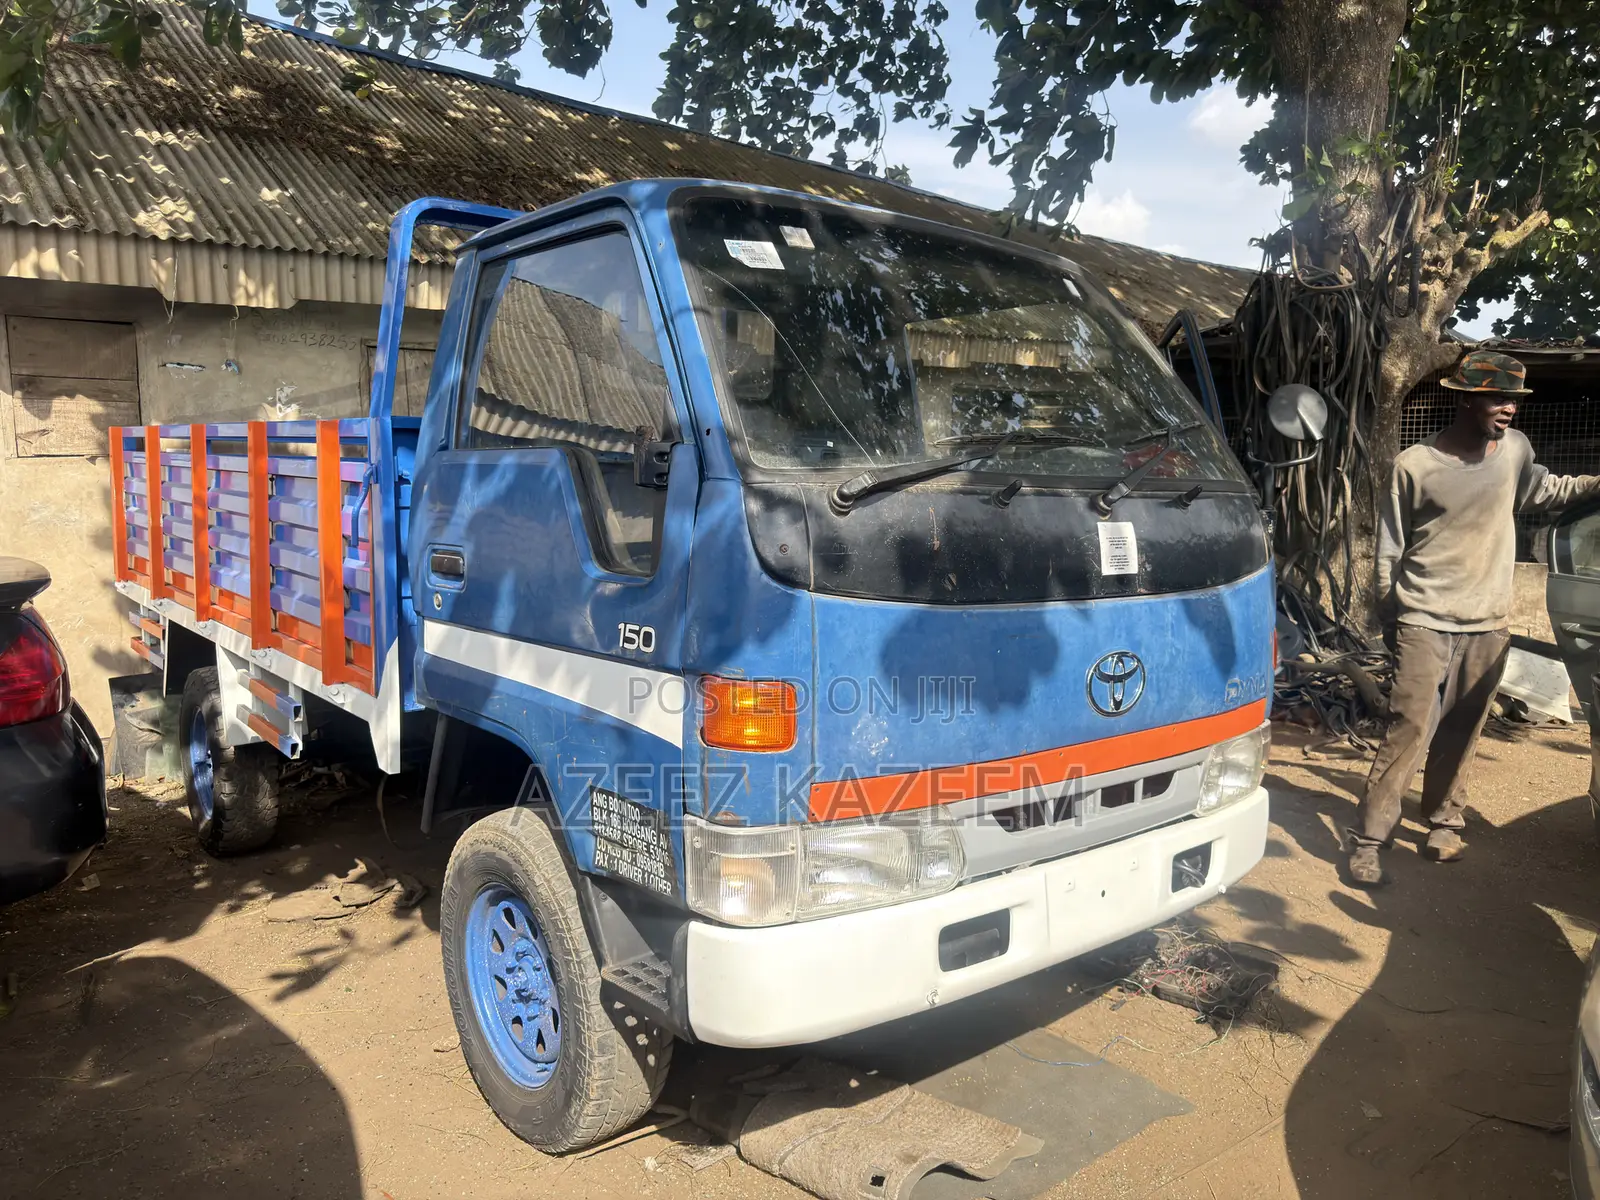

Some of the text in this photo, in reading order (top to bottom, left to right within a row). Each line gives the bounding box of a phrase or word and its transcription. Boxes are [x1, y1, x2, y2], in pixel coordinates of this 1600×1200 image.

[618, 622, 655, 653] 150
[593, 792, 607, 809] ANG
[627, 803, 641, 823] TOO
[622, 816, 657, 846] HOUGANG
[595, 851, 609, 869] PAX
[618, 859, 643, 885] DRIVER
[649, 874, 673, 896] OTHER
